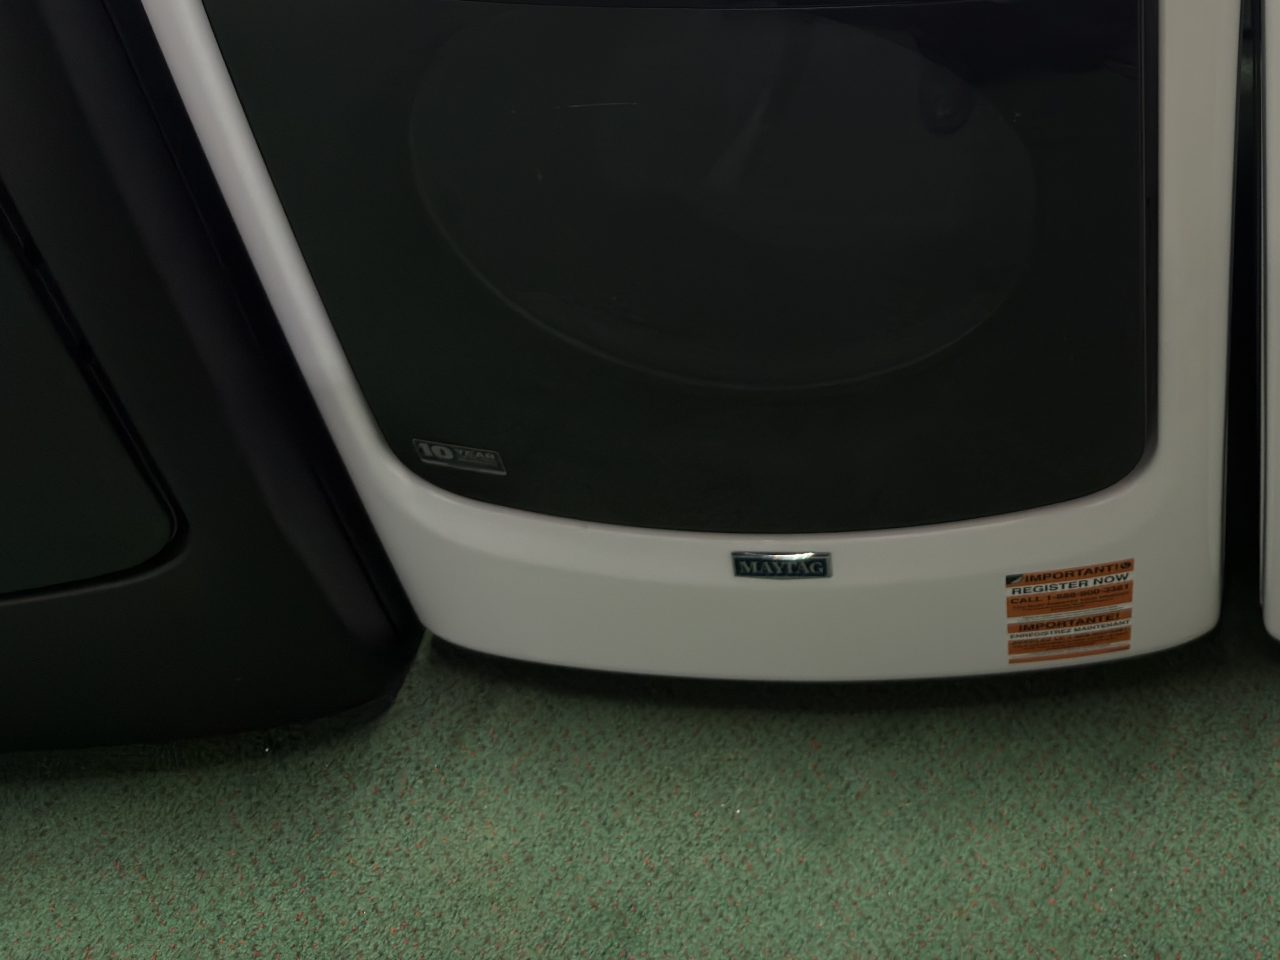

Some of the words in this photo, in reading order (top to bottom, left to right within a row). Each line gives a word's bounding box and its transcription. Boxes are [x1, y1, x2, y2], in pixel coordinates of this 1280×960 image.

[418, 442, 454, 460] 10
[740, 560, 825, 575] MAYTAG
[1012, 580, 1088, 595] REGISTER
[1093, 573, 1129, 585] NOW
[1010, 596, 1041, 605] CALL
